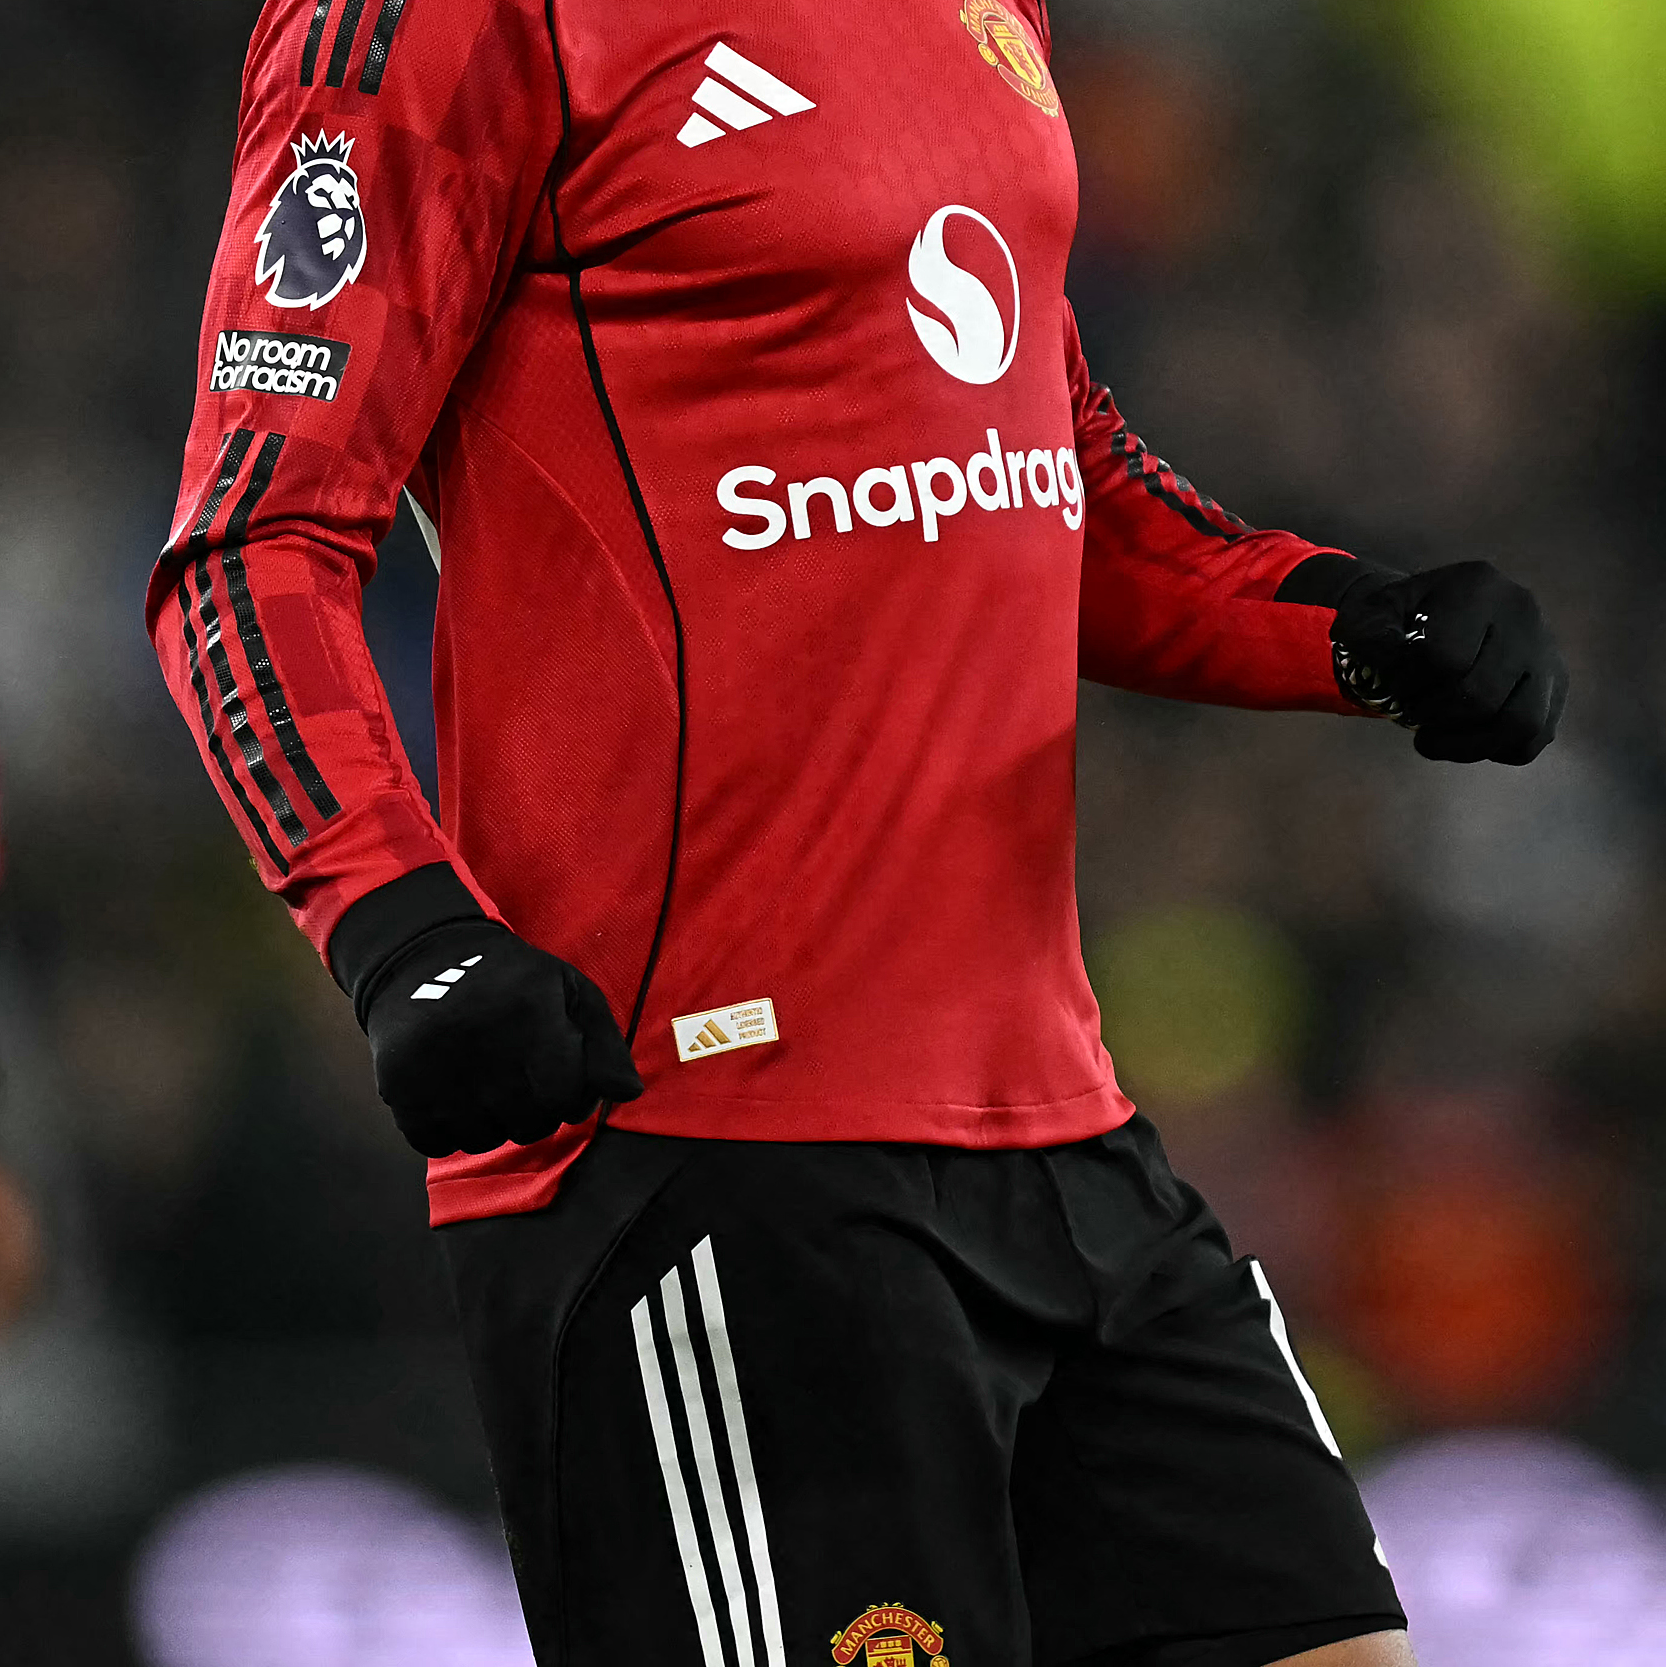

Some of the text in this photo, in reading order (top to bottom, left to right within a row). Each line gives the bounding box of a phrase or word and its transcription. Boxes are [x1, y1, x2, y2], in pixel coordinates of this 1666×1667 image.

[215, 331, 331, 371] No room
[240, 361, 338, 401] racism
[716, 428, 1085, 550] Snapdrag
[840, 1612, 935, 1656] MANCHESTER
